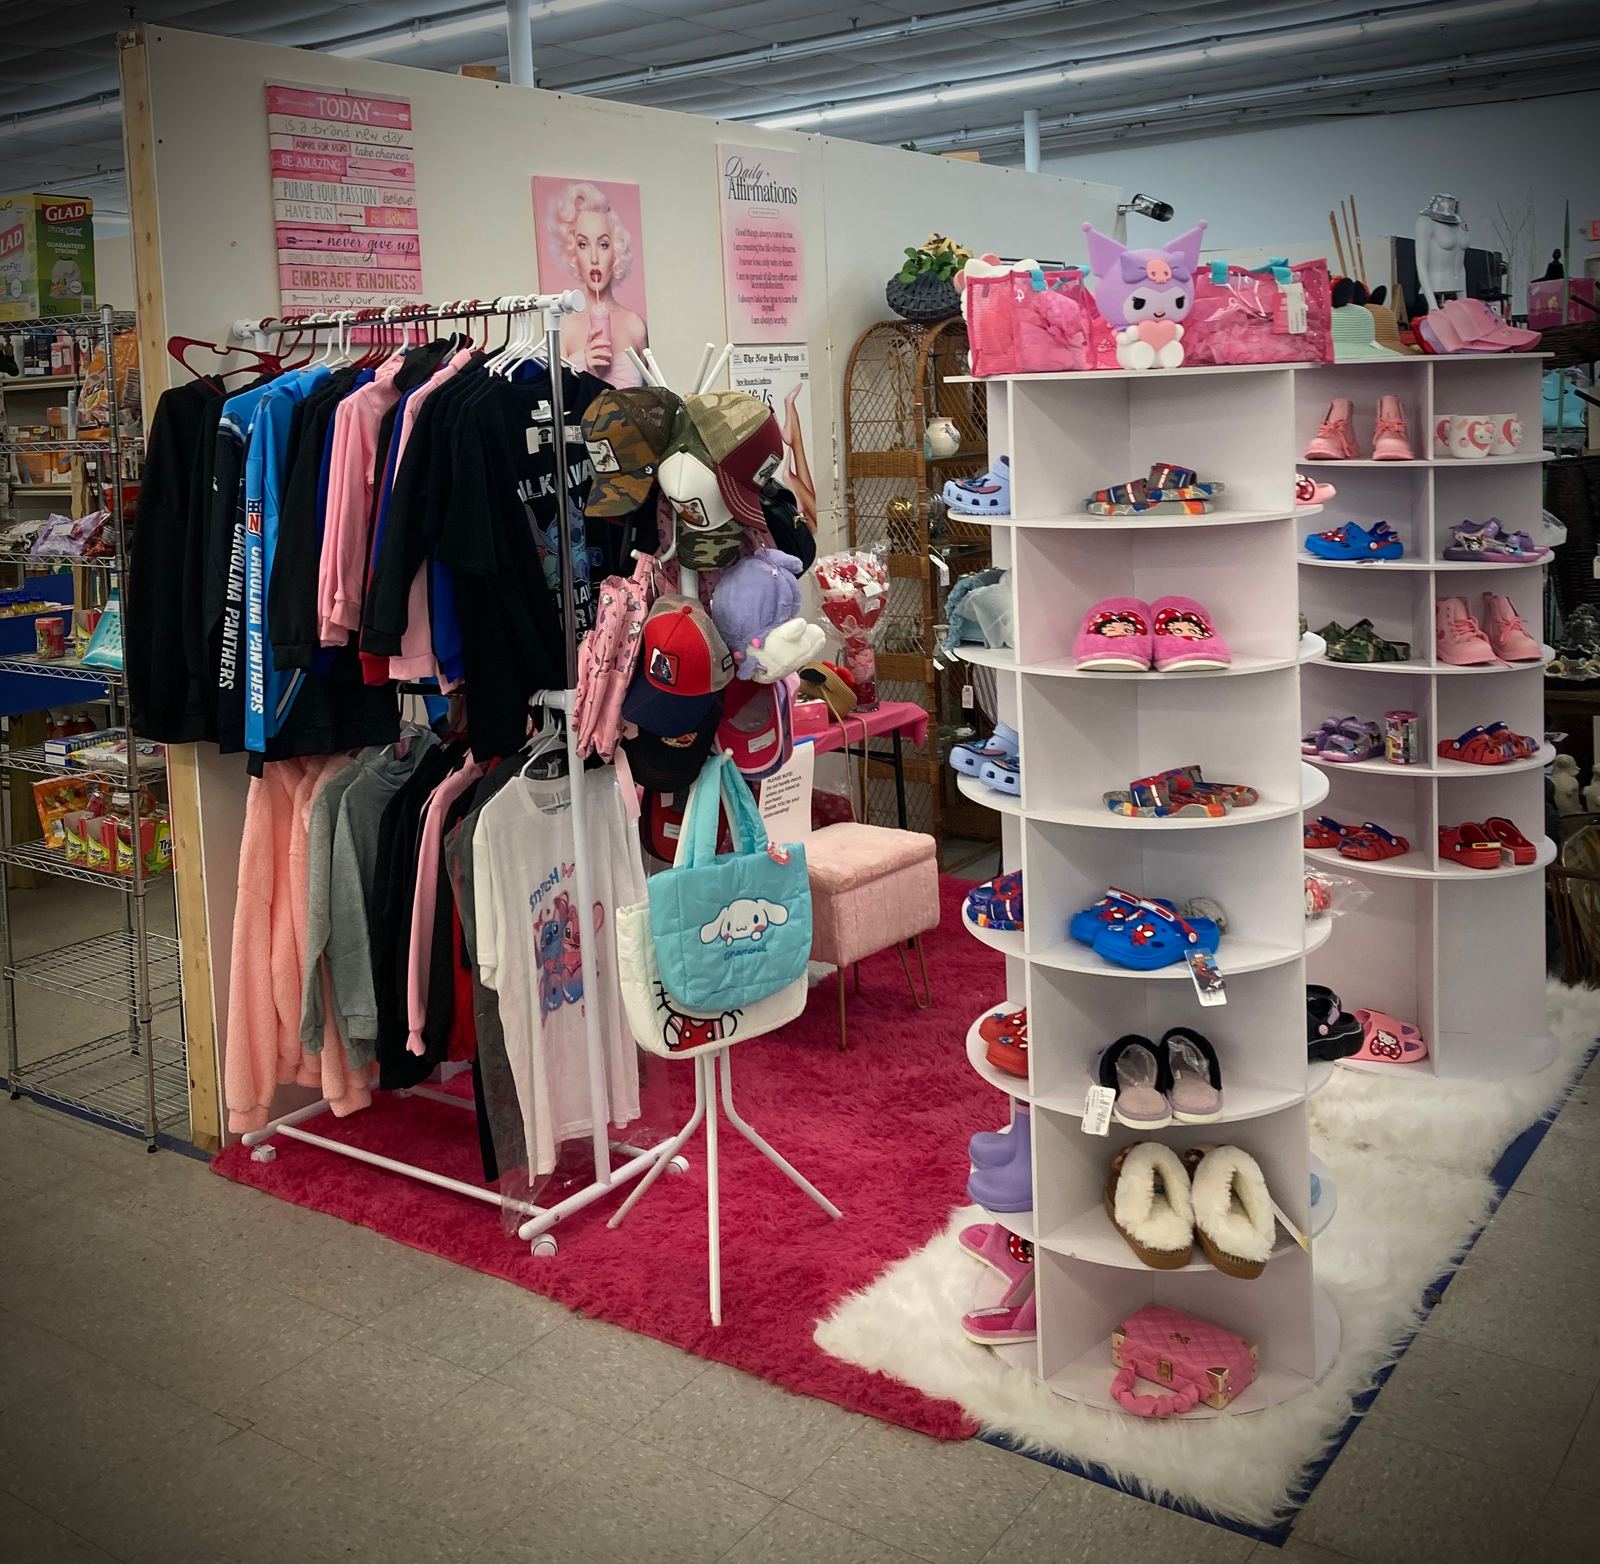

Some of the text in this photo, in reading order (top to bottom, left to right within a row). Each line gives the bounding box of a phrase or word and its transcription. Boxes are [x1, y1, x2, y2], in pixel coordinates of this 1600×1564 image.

[315, 97, 372, 121] TODAY
[285, 119, 405, 144] is a brand new day
[281, 154, 341, 170] BE AMAZING
[355, 146, 410, 161] take chances
[724, 155, 765, 184] Daily
[283, 181, 377, 205] PURSUE YOUR PASSION
[383, 190, 413, 206] believe
[727, 176, 798, 205] Affirmations
[45, 205, 85, 221] GLAD
[285, 204, 333, 220] HAVE FUN
[0, 230, 23, 255] LAD
[46, 241, 86, 250] GUARANTEED
[327, 236, 363, 247] never
[363, 240, 393, 262] give
[397, 242, 415, 262] up
[291, 270, 417, 291] EMBRACE KINDNESS
[322, 293, 341, 305] live
[348, 296, 375, 309] your
[743, 354, 755, 363] The
[755, 353, 768, 363] New
[769, 353, 783, 364] York
[784, 353, 799, 363] Press
[218, 522, 247, 690] CAROLINA PANTHERS
[249, 629, 264, 714] PANTHERS
